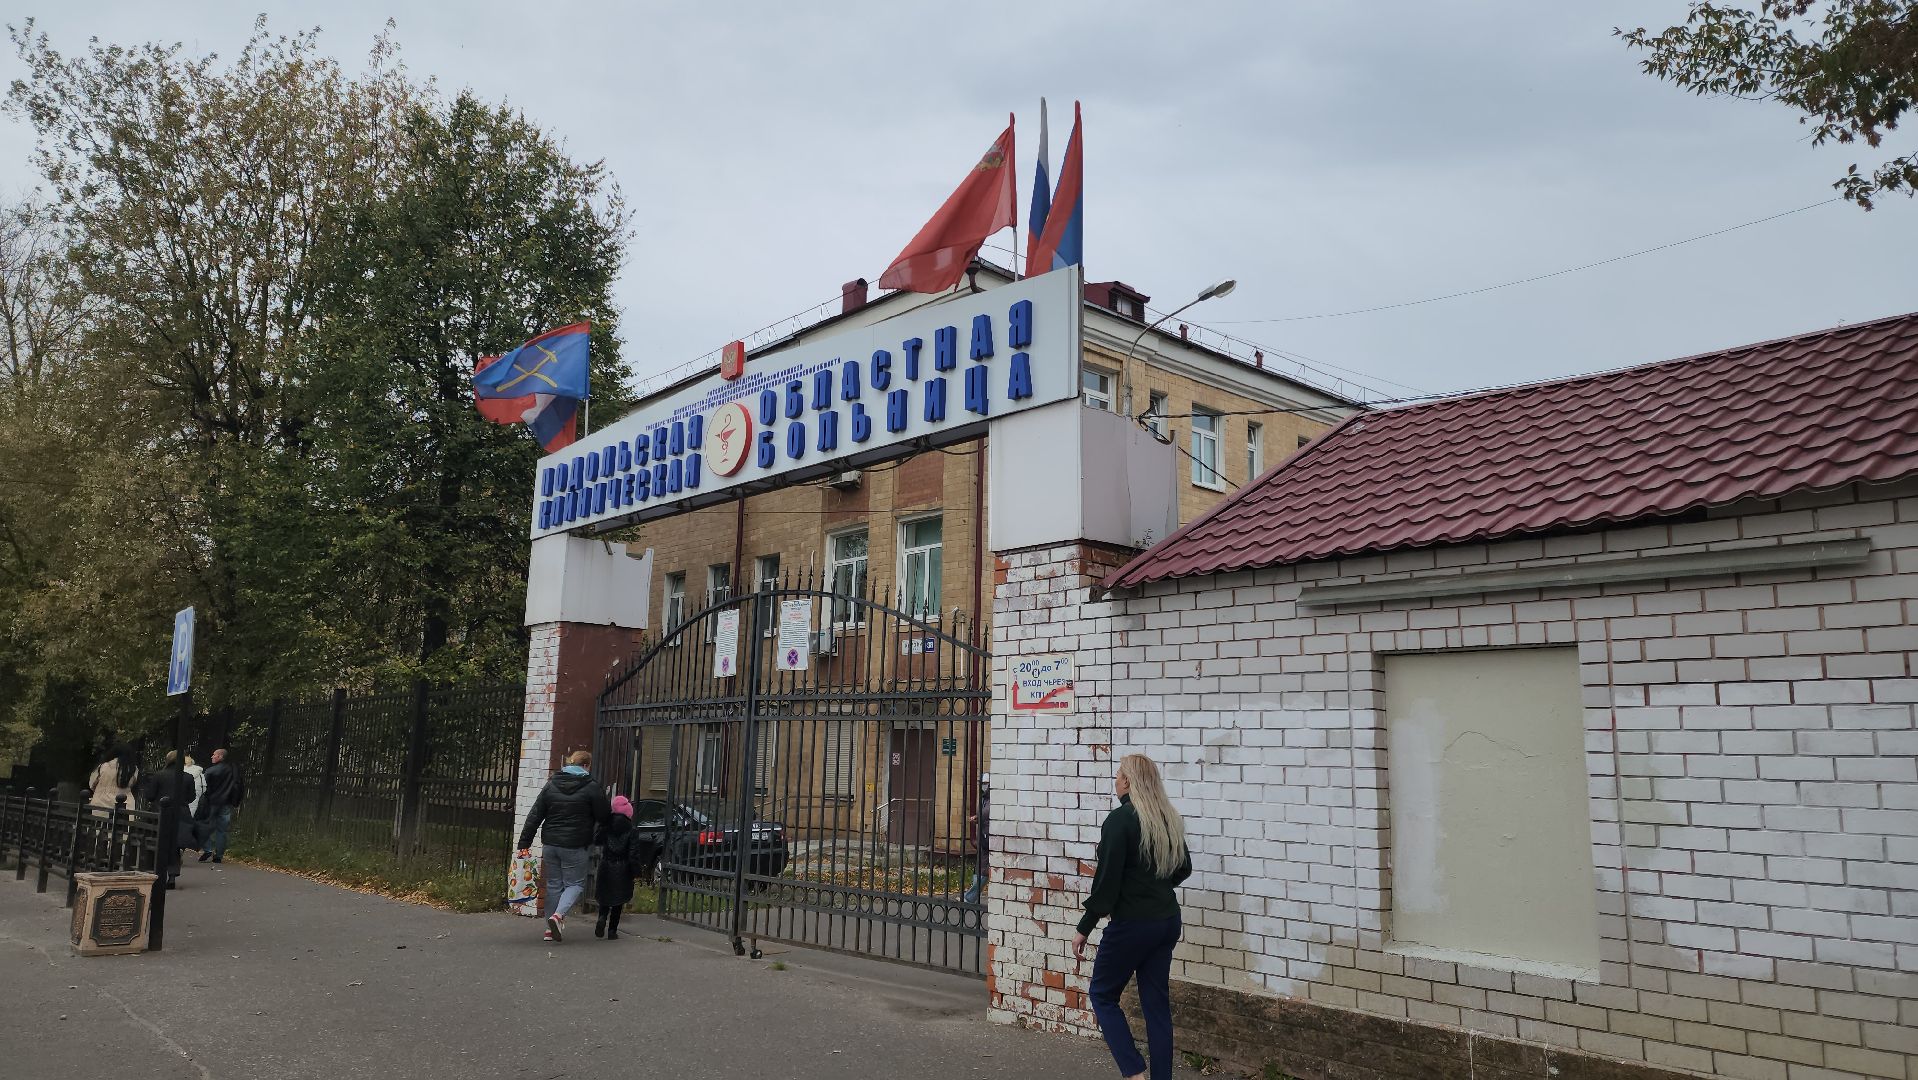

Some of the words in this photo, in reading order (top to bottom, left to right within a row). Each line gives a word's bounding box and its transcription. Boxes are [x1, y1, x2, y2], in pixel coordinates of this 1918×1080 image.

[538, 453, 701, 529] КЛИНИЧЕСКАЯ
[758, 352, 1032, 468] БОЛЬНИЦА
[541, 415, 703, 497] ПОДОЛЬСКАЯ
[760, 300, 1032, 426] ОБЛАСТНАЯ
[1023, 679, 1041, 687] ВХОД
[1044, 678, 1065, 686] ЧЕРЕЗ
